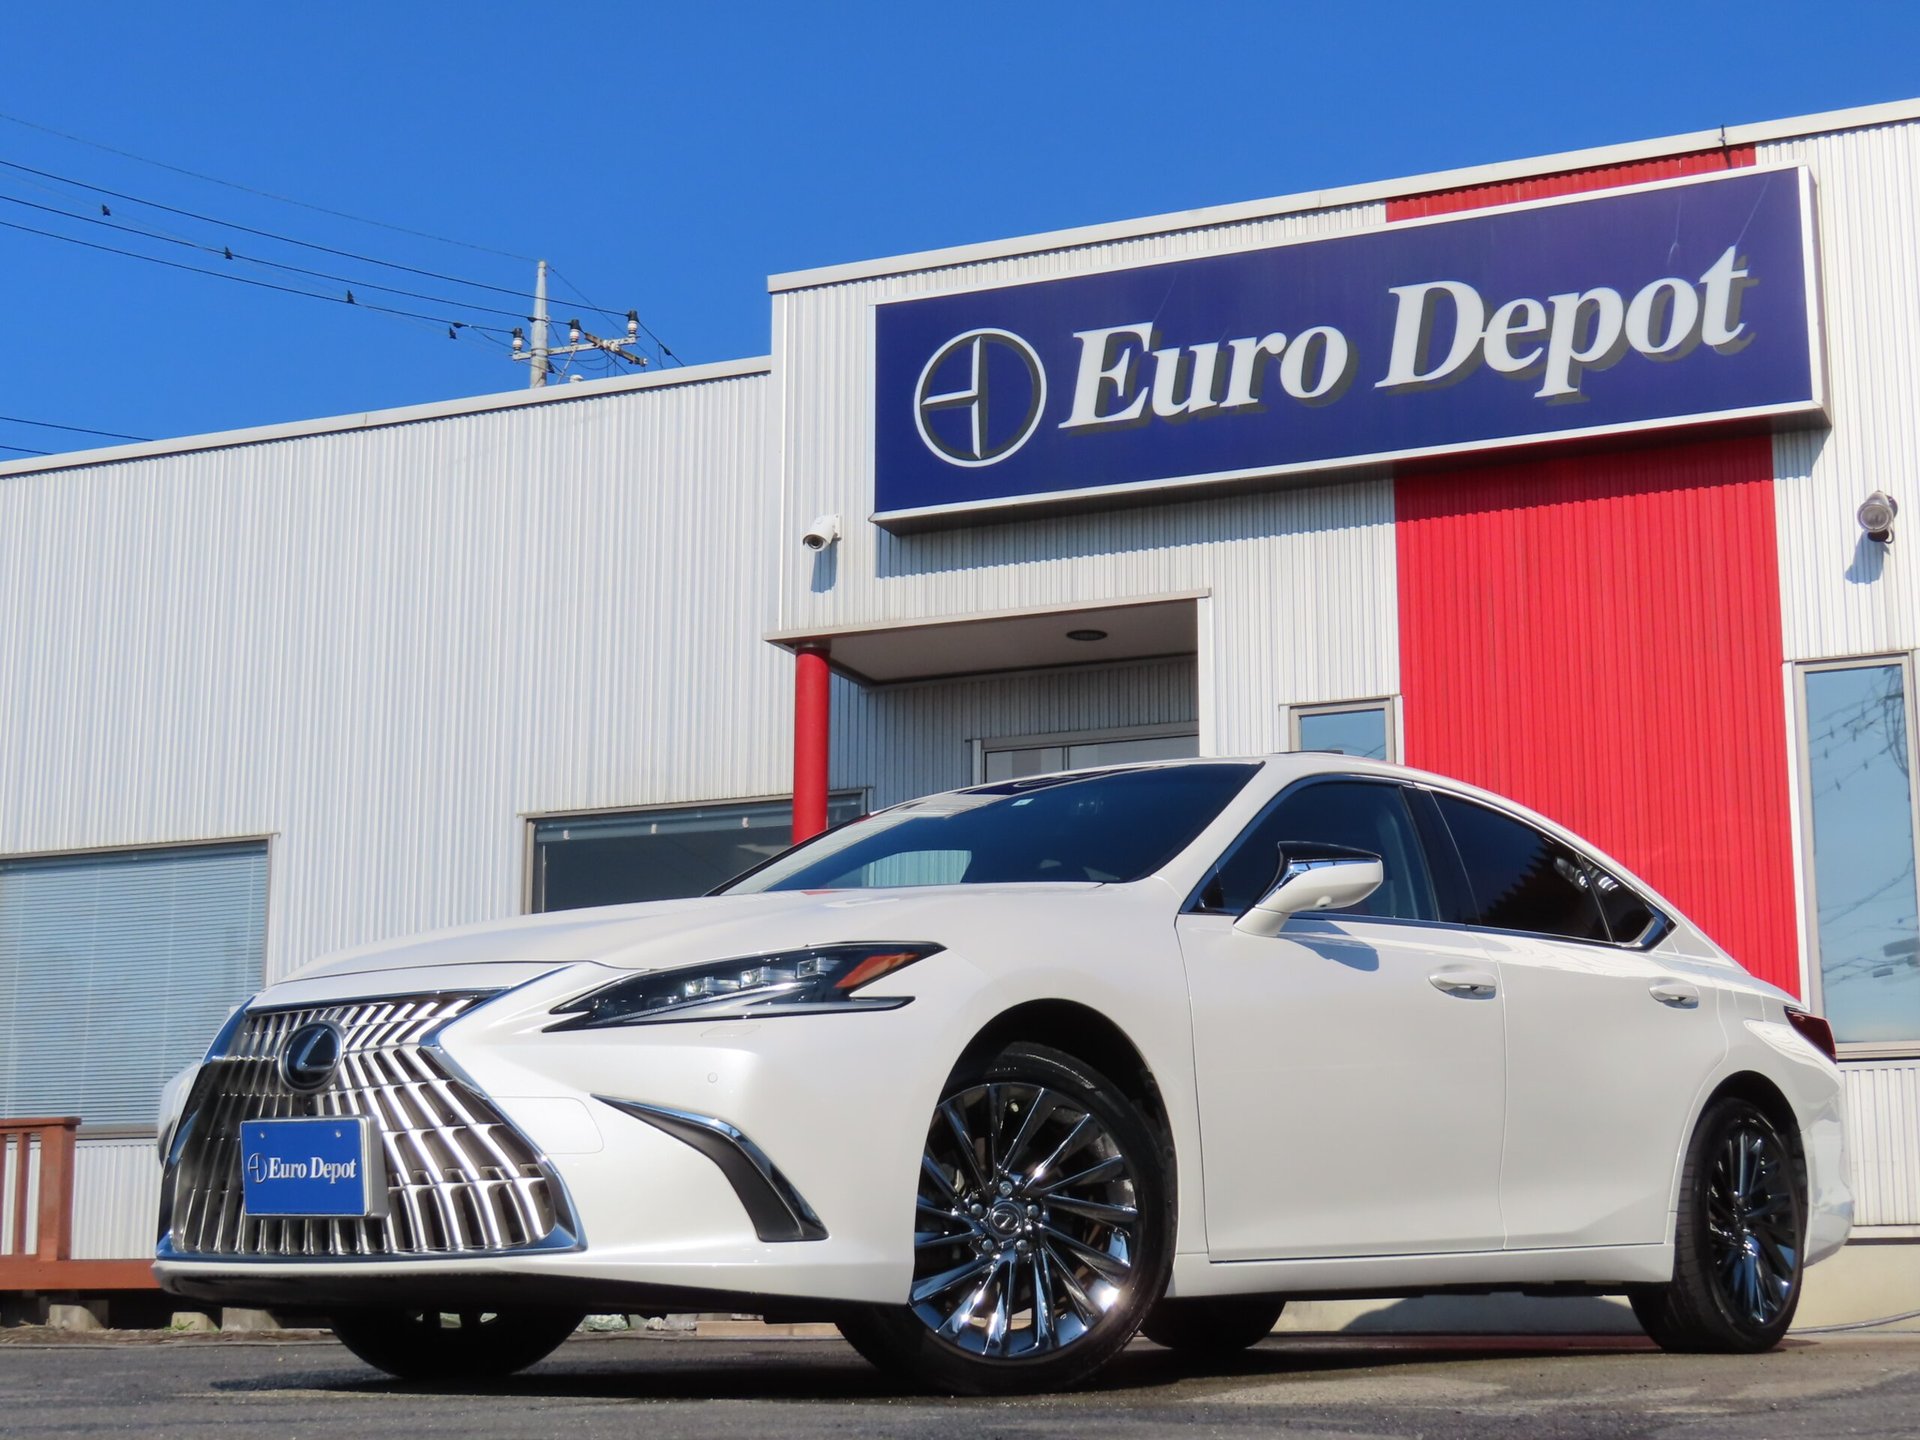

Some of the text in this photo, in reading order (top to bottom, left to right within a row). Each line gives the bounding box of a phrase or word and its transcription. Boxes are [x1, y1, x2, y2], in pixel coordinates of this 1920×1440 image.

[1058, 245, 1750, 430] Euro Depot
[268, 1156, 357, 1184] Euro Depot
